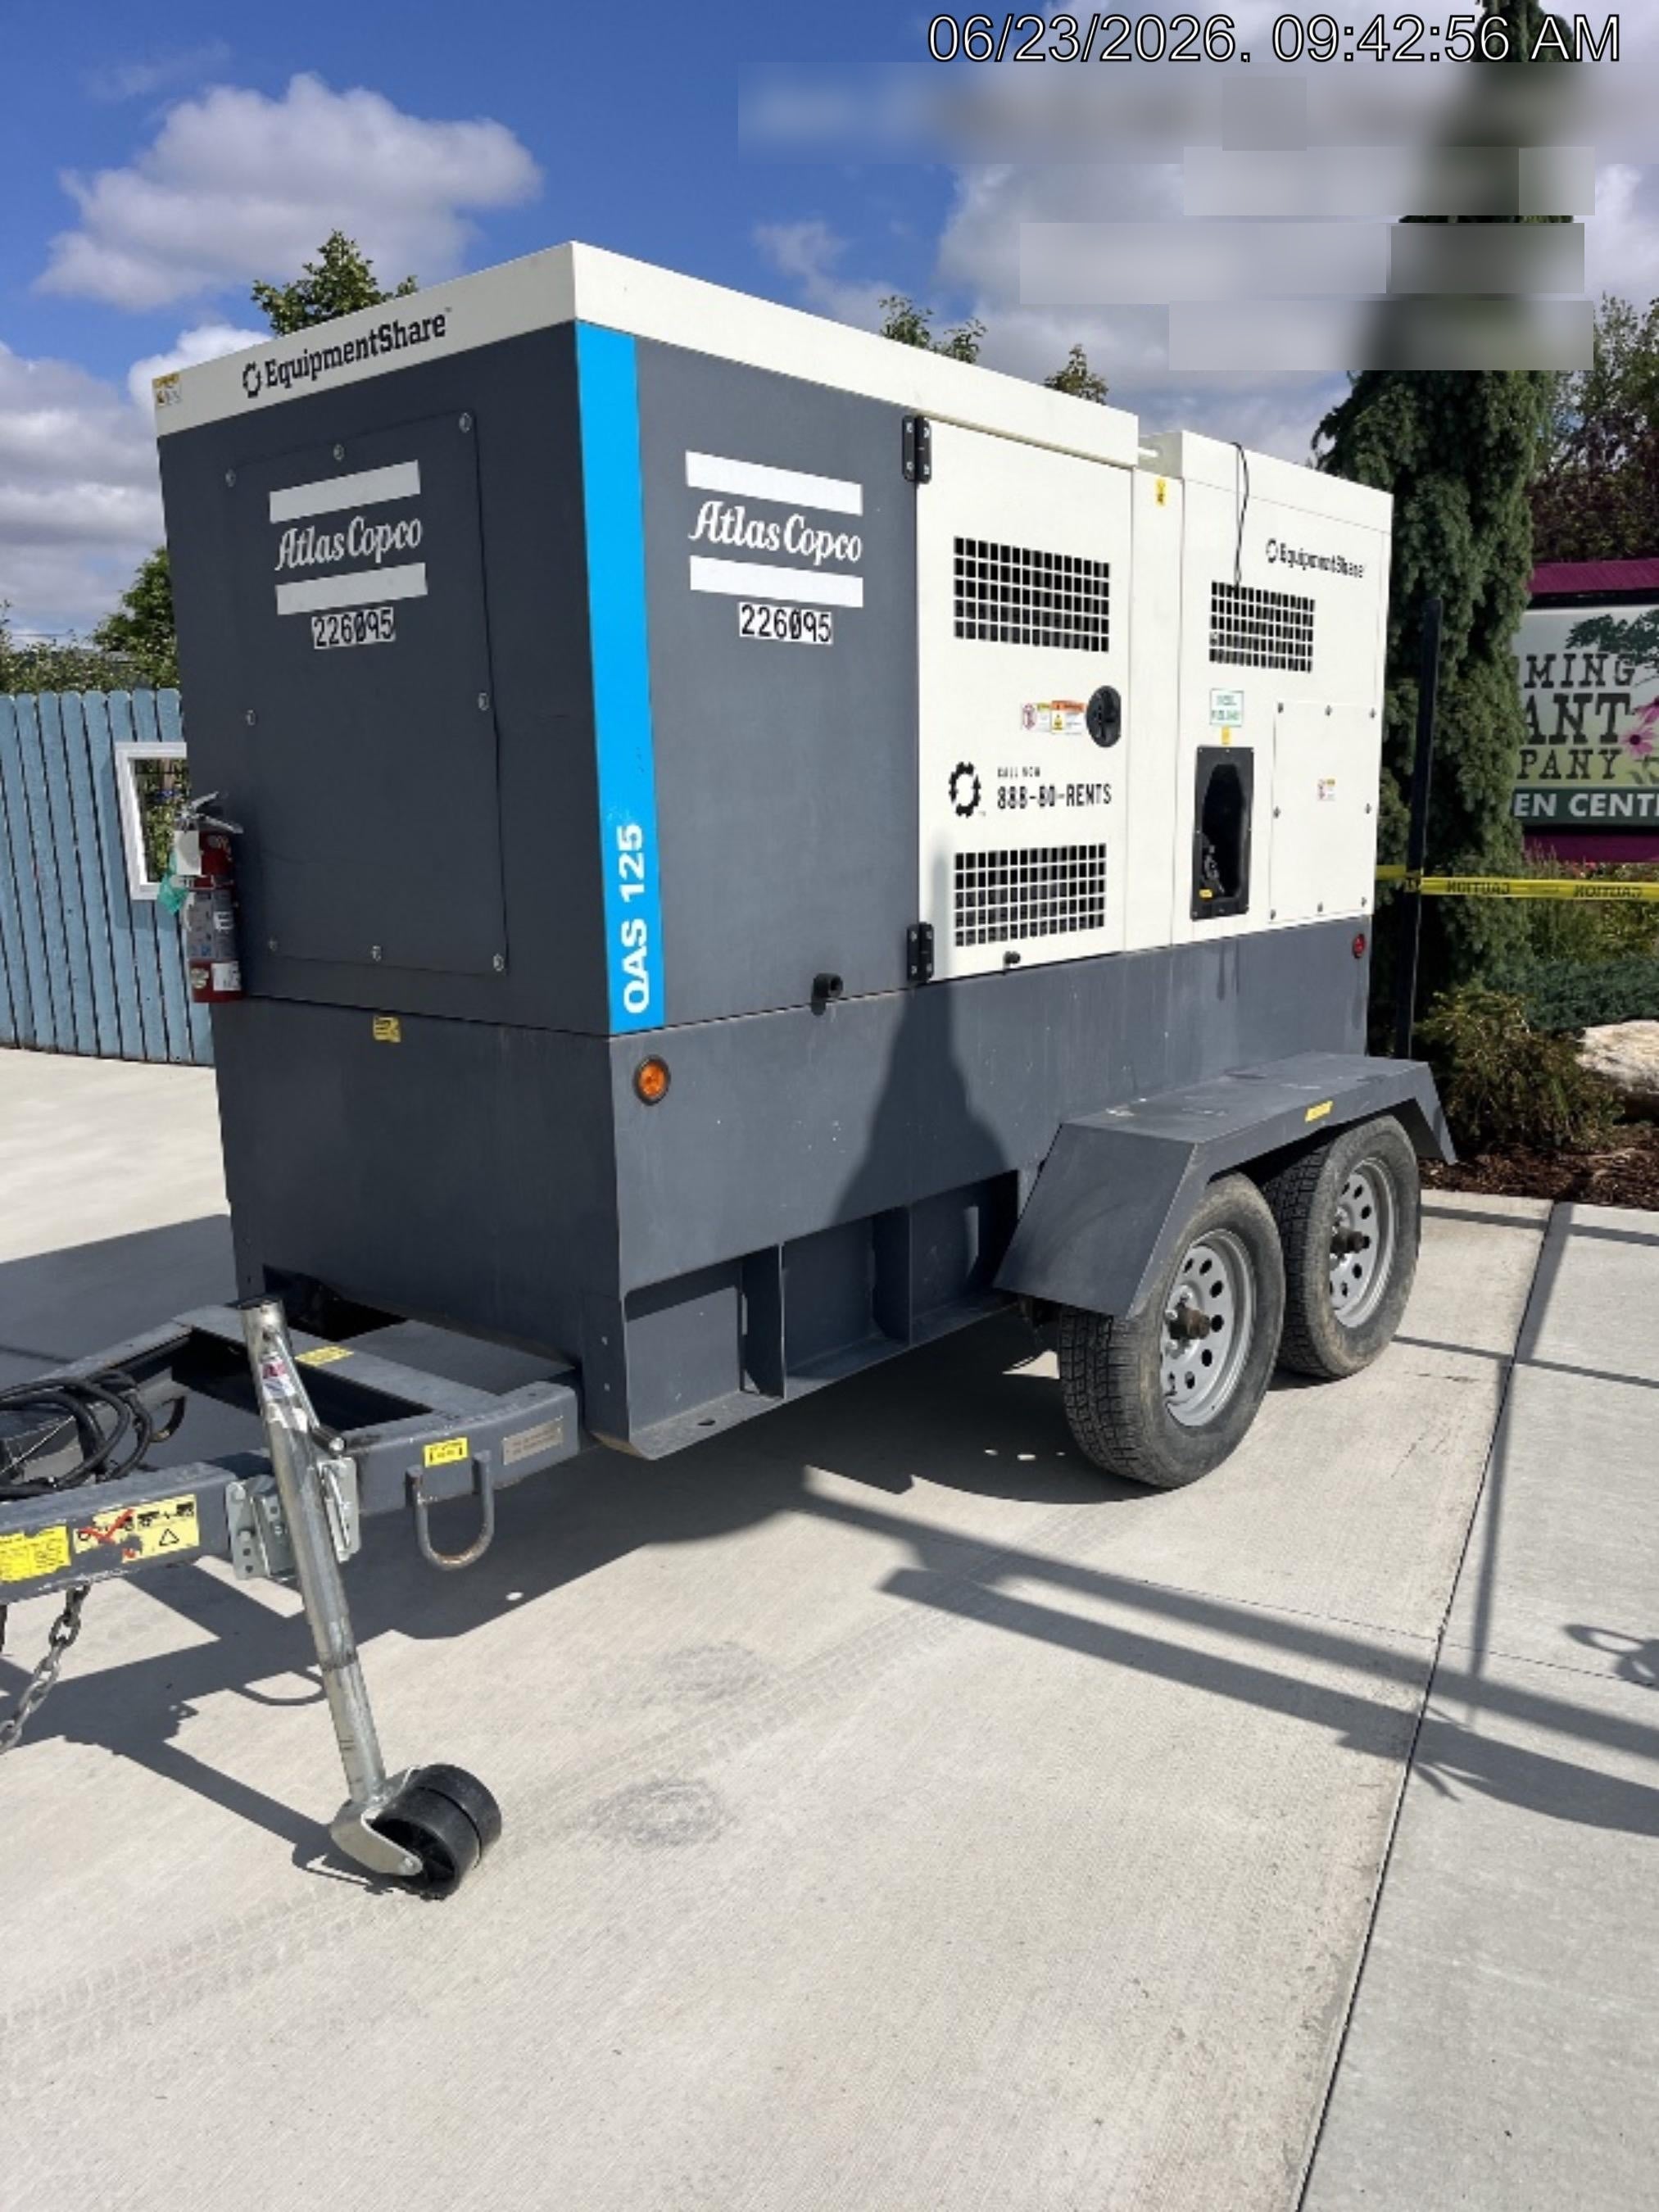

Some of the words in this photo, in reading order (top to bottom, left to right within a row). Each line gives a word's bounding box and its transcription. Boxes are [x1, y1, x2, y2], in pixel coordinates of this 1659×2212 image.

[265, 314, 446, 388] EquipmentShare
[314, 609, 392, 646] 226095
[741, 605, 831, 642] 226095
[616, 823, 645, 903] 125
[621, 918, 650, 1013] QAS
